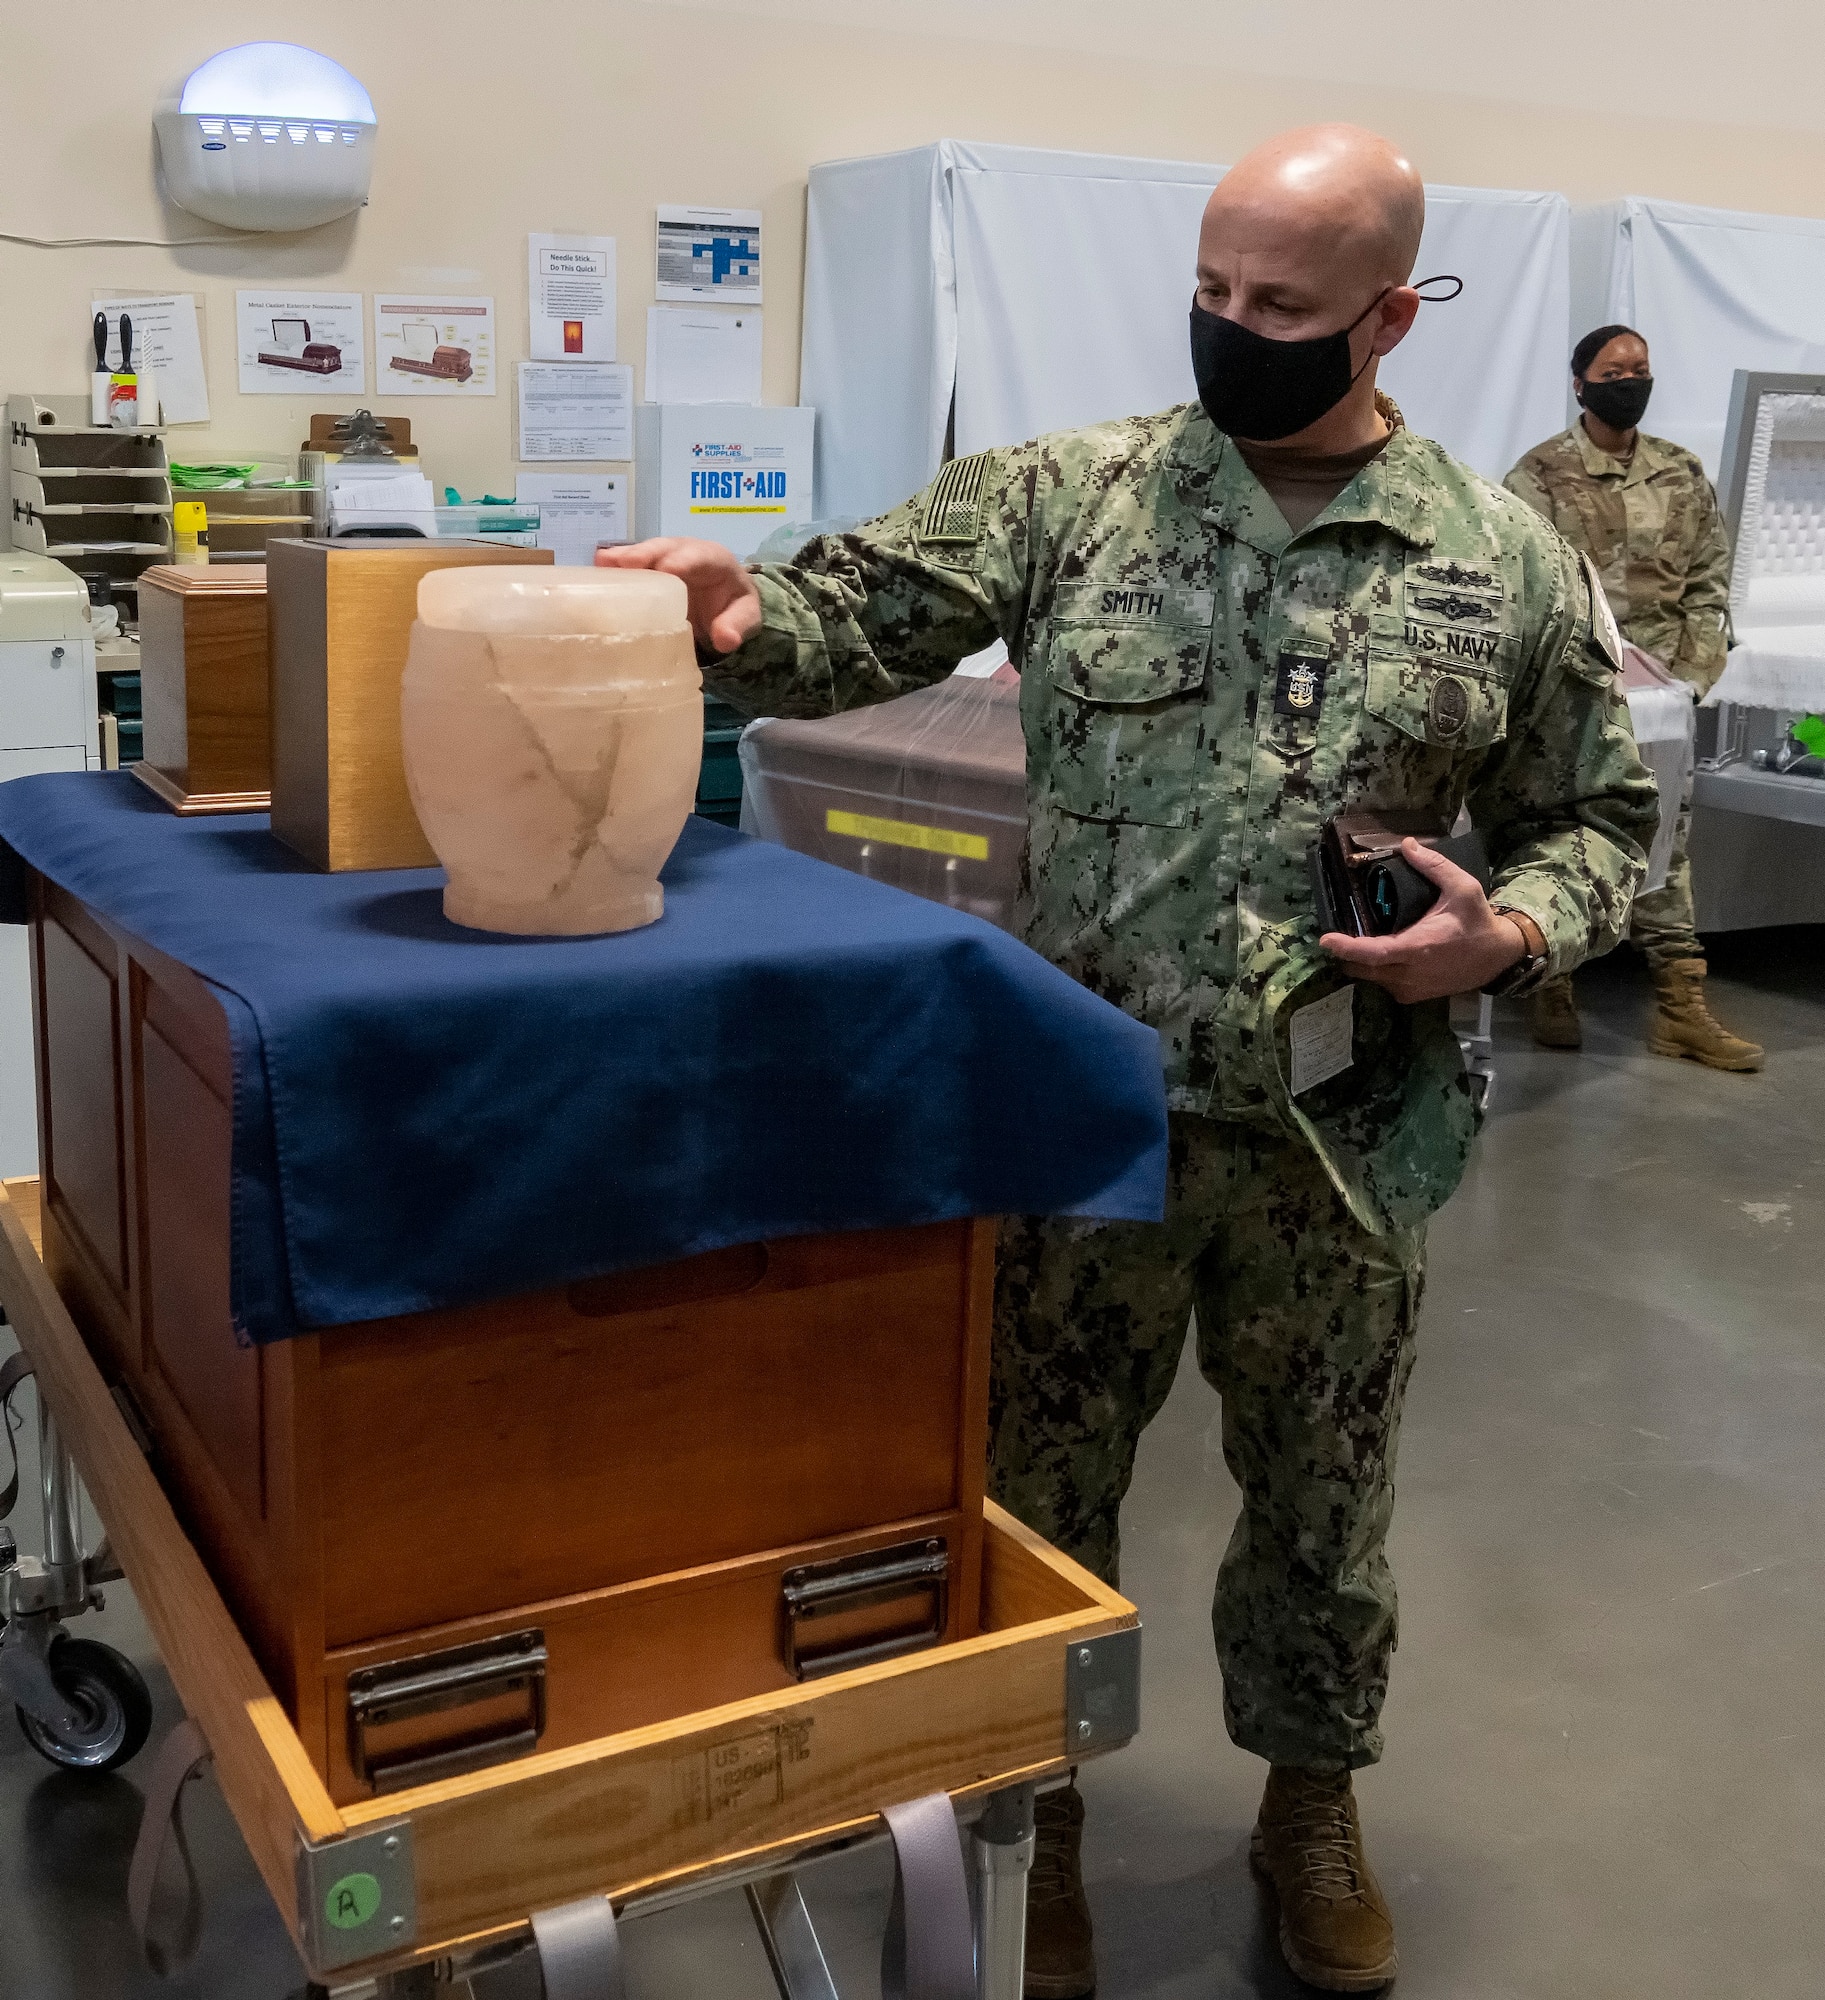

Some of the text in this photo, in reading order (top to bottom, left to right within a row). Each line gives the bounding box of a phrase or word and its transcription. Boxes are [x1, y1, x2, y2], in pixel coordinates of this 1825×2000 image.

[691, 472, 786, 498] FIRST AID
[1101, 591, 1164, 615] SMITH
[1404, 624, 1498, 663] U.S. NAVY
[337, 1888, 360, 1918] A
